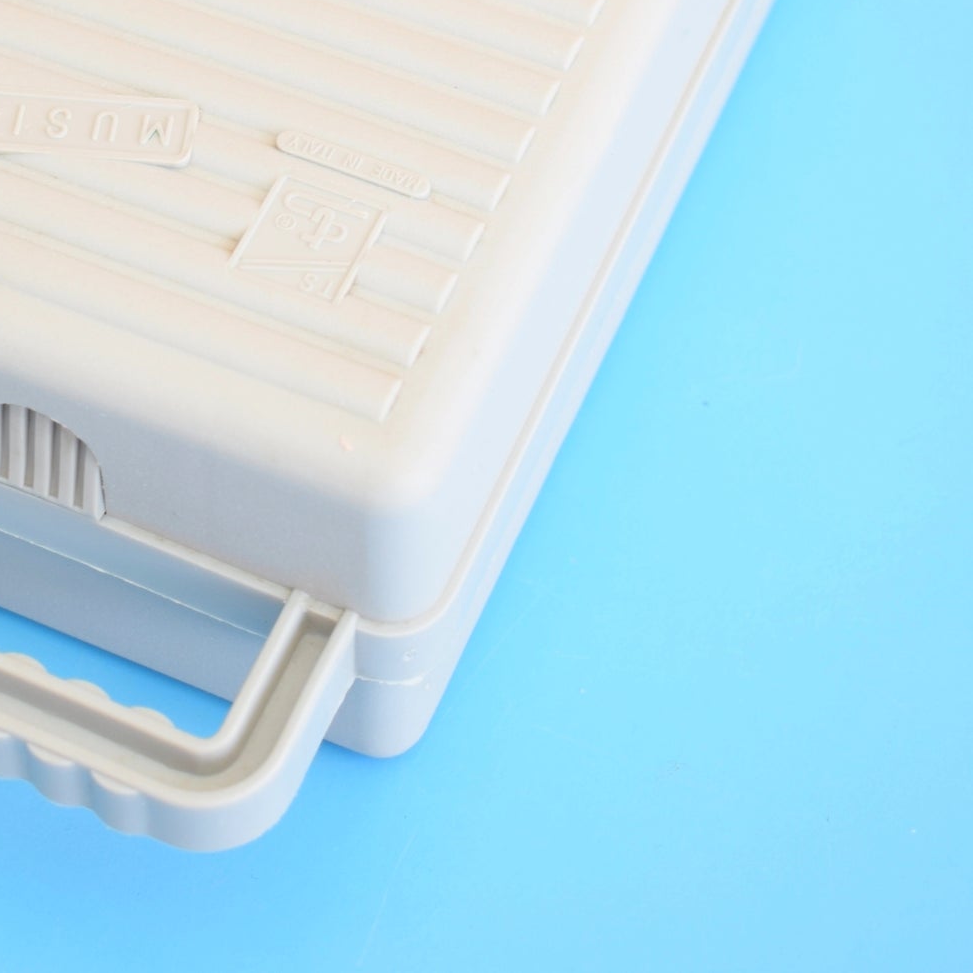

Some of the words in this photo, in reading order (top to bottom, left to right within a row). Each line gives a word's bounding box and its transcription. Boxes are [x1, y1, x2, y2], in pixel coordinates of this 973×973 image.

[287, 132, 336, 162] ITALY
[342, 151, 365, 172] IN
[370, 161, 422, 192] MADE
